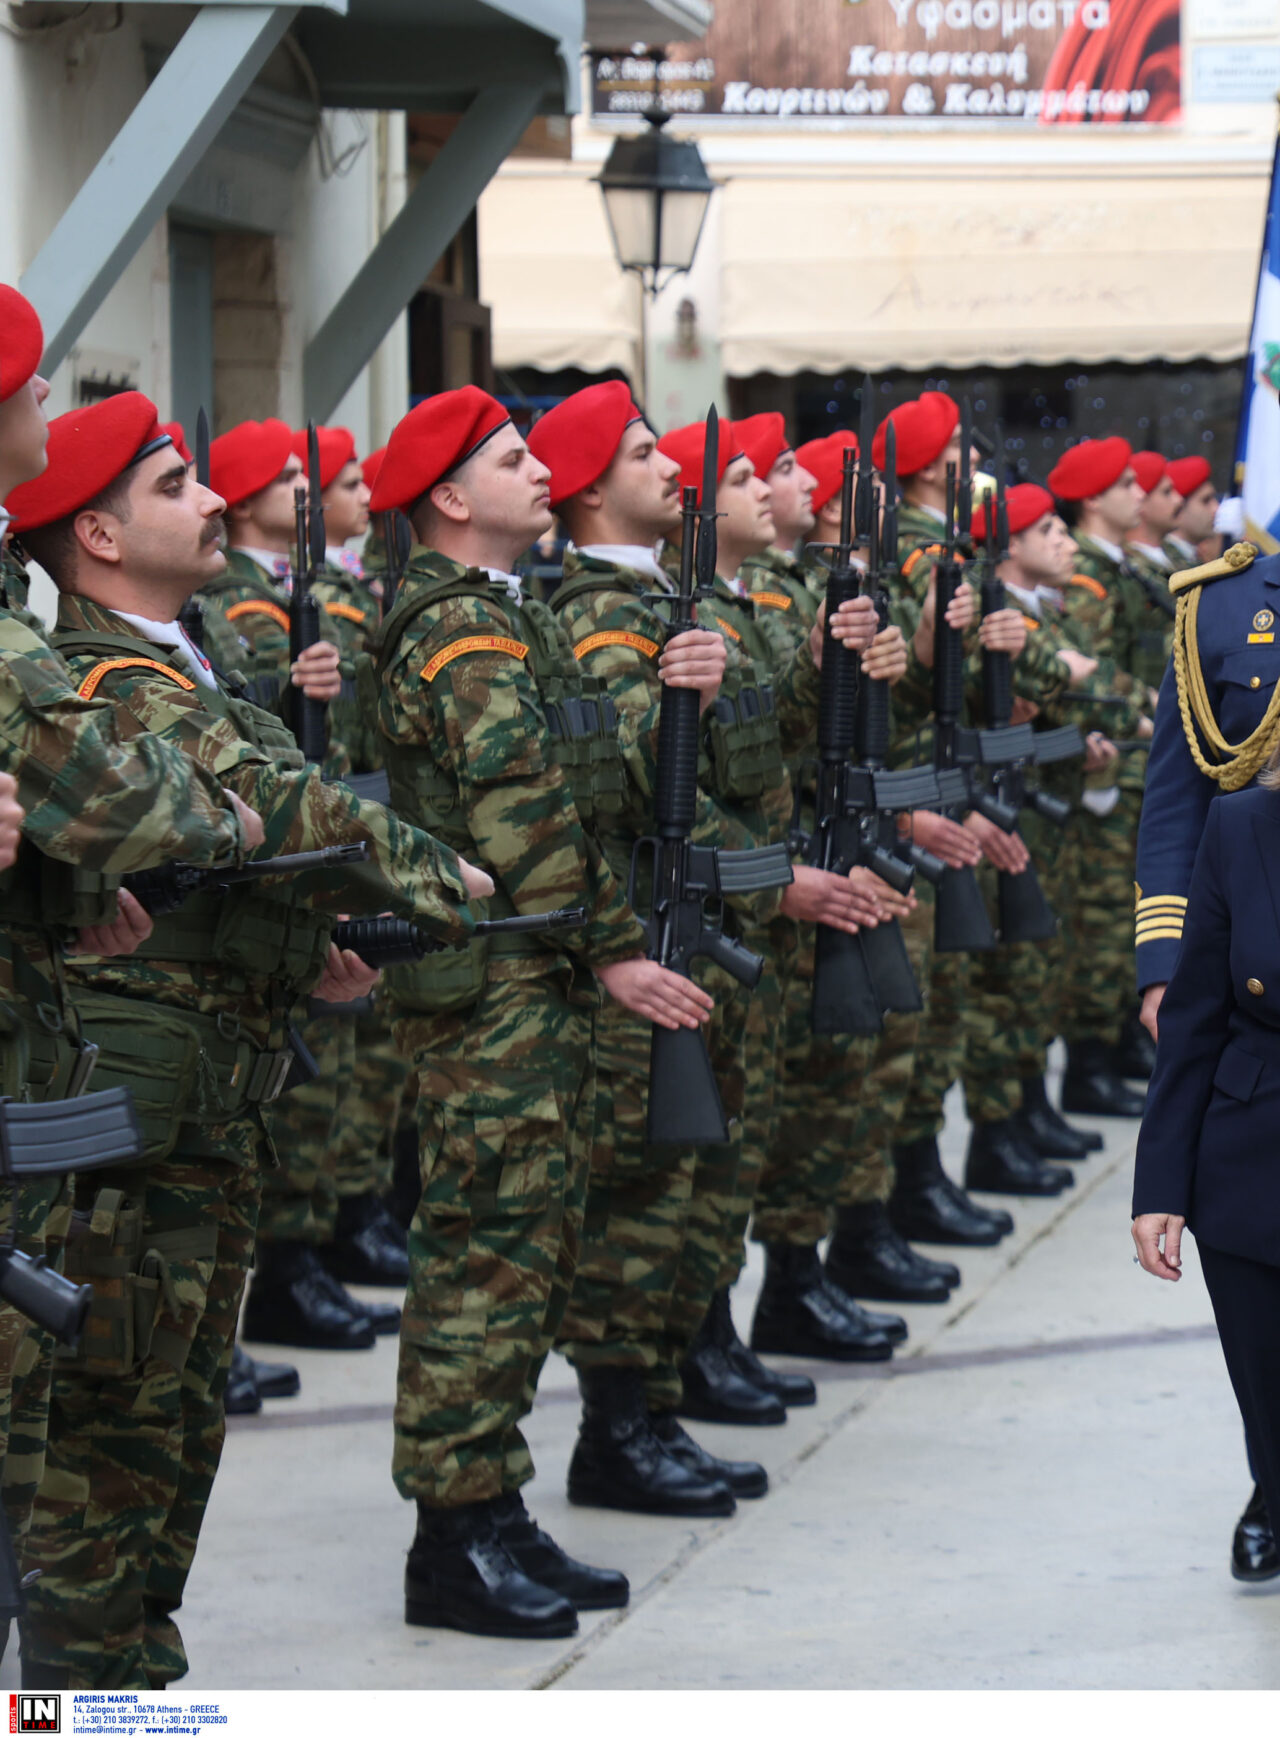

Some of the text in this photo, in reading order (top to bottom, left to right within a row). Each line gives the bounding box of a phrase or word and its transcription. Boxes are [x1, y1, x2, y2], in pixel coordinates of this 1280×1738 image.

[847, 43, 1029, 84] Κατασκευή
[721, 79, 1150, 120] Κουρτινών & Καλυμμάτων
